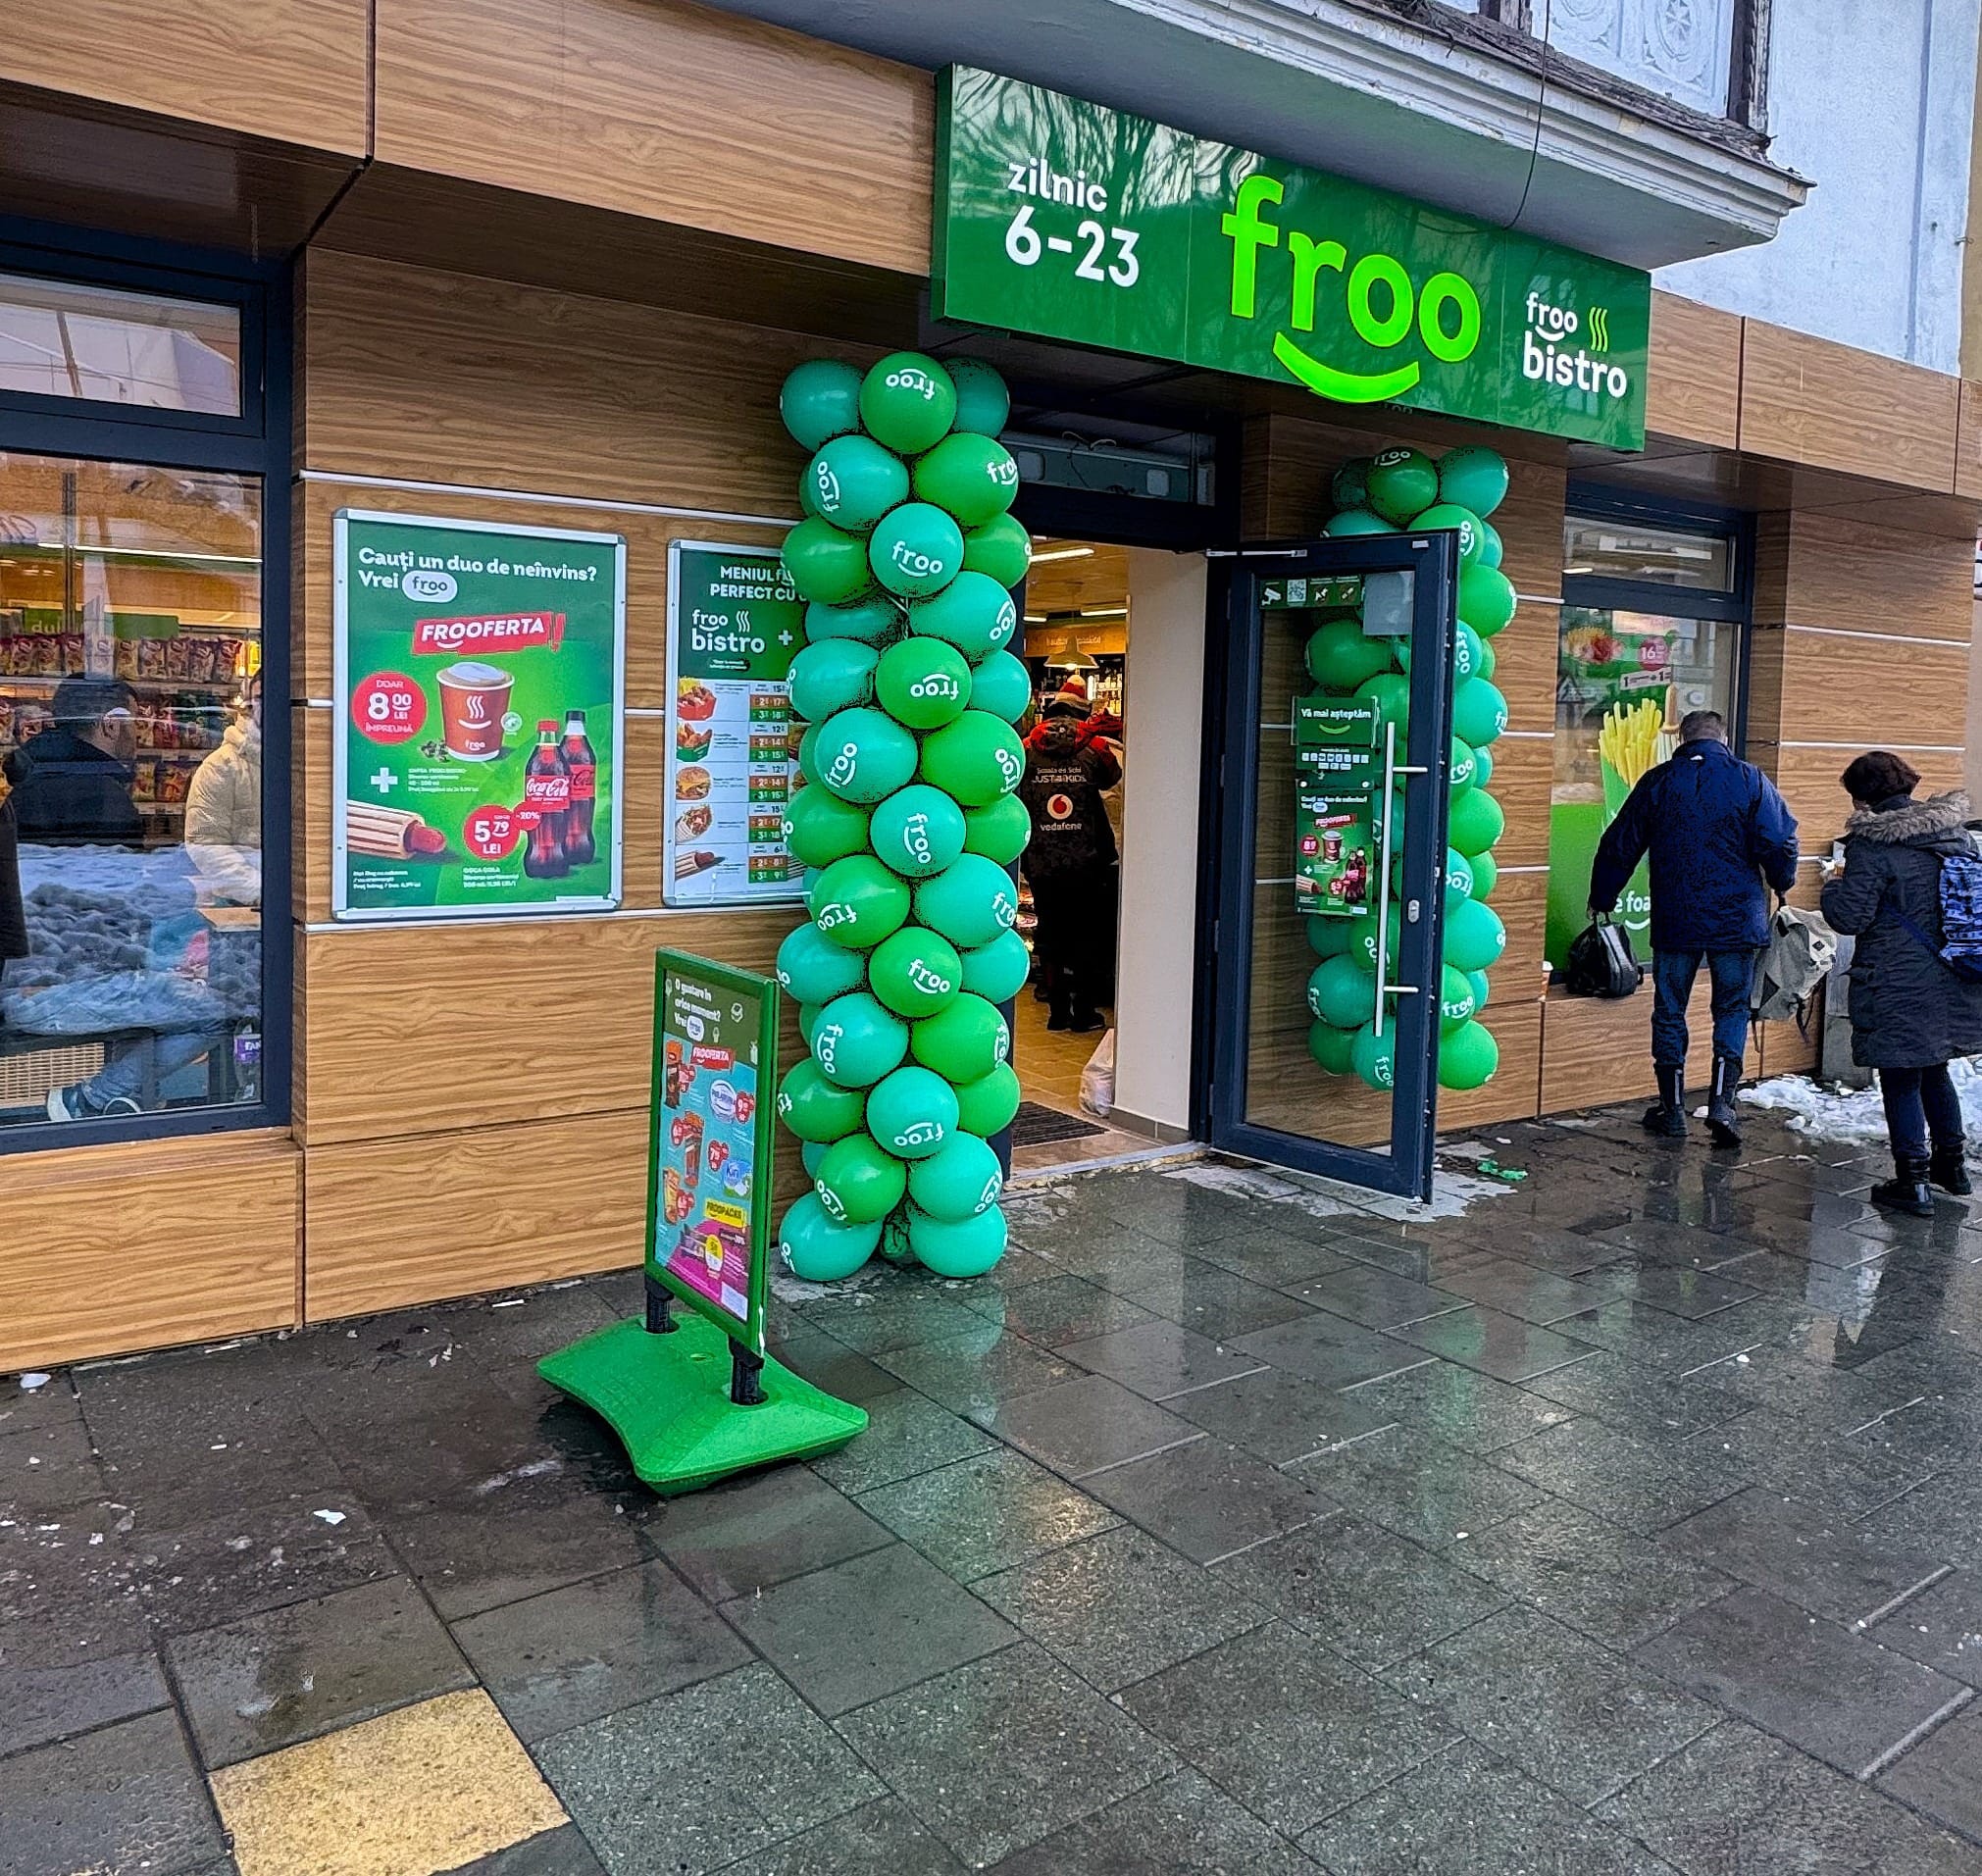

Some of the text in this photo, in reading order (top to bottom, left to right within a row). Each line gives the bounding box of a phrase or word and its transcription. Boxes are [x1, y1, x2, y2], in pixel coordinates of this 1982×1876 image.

[1007, 156, 1108, 213] zilnic
[1004, 205, 1141, 288] 6-23
[1221, 175, 1483, 364] froo
[1524, 291, 1579, 334] froo
[1522, 336, 1628, 399] bistro
[885, 374, 936, 401] froo
[358, 546, 597, 582] Cauți un duo de neînvins?
[891, 540, 944, 575] froo
[358, 569, 448, 592] Vrei froo
[720, 566, 775, 582] MENIUL
[709, 583, 795, 602] PERFECT CU
[421, 617, 545, 642] FROOFERTA
[691, 609, 729, 627] froo
[691, 628, 765, 654] bistro
[910, 680, 959, 701] froo
[368, 692, 389, 720] 8
[825, 742, 858, 787] froo
[1449, 759, 1474, 780] roo
[474, 820, 510, 842] 5 79
[907, 813, 932, 863] froo
[482, 843, 501, 855] LEI
[1626, 889, 1652, 913] foa
[907, 958, 951, 993] froo
[893, 1122, 944, 1146] froo
